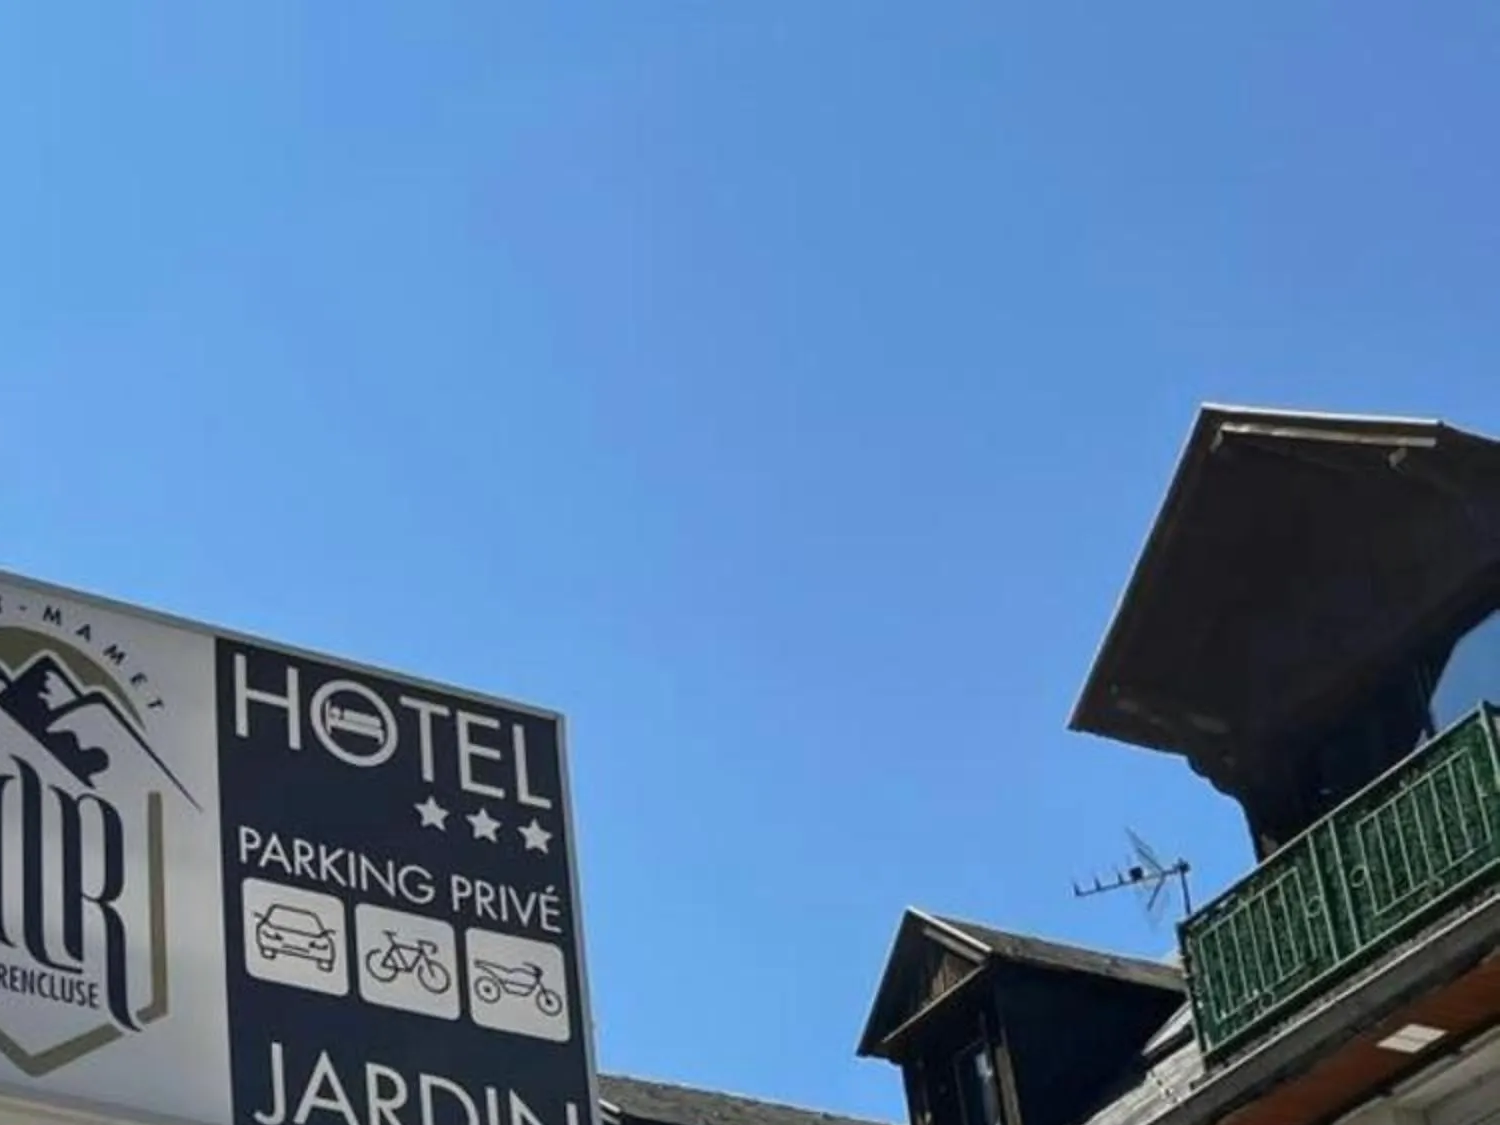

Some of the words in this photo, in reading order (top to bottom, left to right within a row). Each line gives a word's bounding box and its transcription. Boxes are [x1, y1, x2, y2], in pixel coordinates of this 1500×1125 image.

[234, 653, 552, 809] HOTEL
[239, 826, 435, 904] PARKING
[451, 875, 562, 933] PRIVÉ
